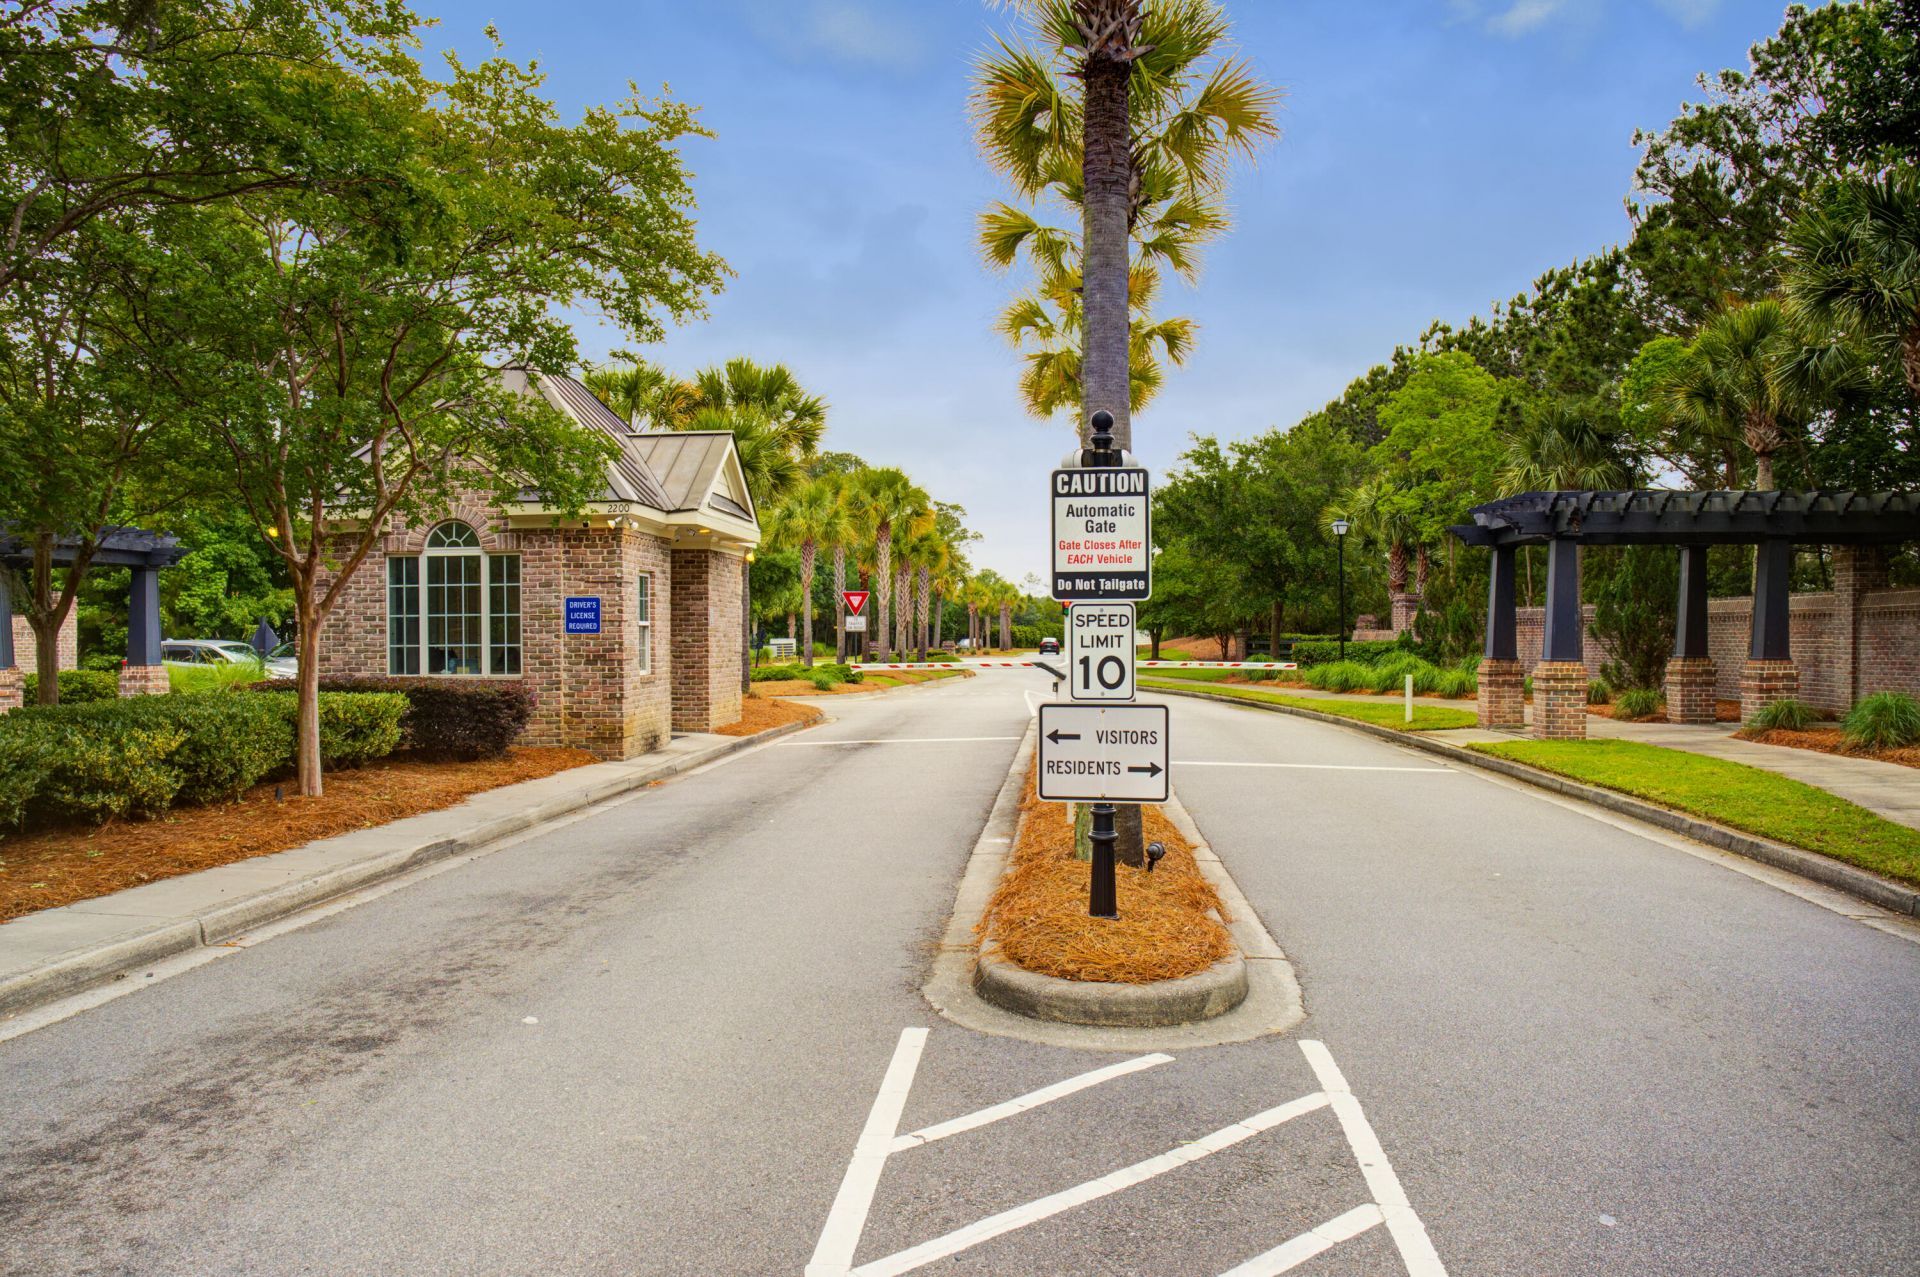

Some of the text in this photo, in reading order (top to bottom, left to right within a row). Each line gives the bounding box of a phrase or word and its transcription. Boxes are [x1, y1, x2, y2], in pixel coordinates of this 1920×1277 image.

[1056, 472, 1144, 494] CAUTION
[607, 503, 630, 513] 2200
[1066, 503, 1135, 518] Automatic
[1085, 519, 1116, 533] Gate
[1059, 539, 1142, 551] Gate Closes After
[1067, 554, 1133, 564] EACH Vehicle
[1057, 578, 1146, 592] Do Not Tailgate
[569, 601, 597, 609] DRIVER'S
[568, 622, 597, 630] REQUIRED
[1075, 614, 1130, 628] SPEED
[1080, 635, 1124, 648] LIMIT
[1079, 655, 1126, 690] 10
[1096, 730, 1158, 745] VISITORS
[1047, 760, 1121, 775] RESIDENTS
